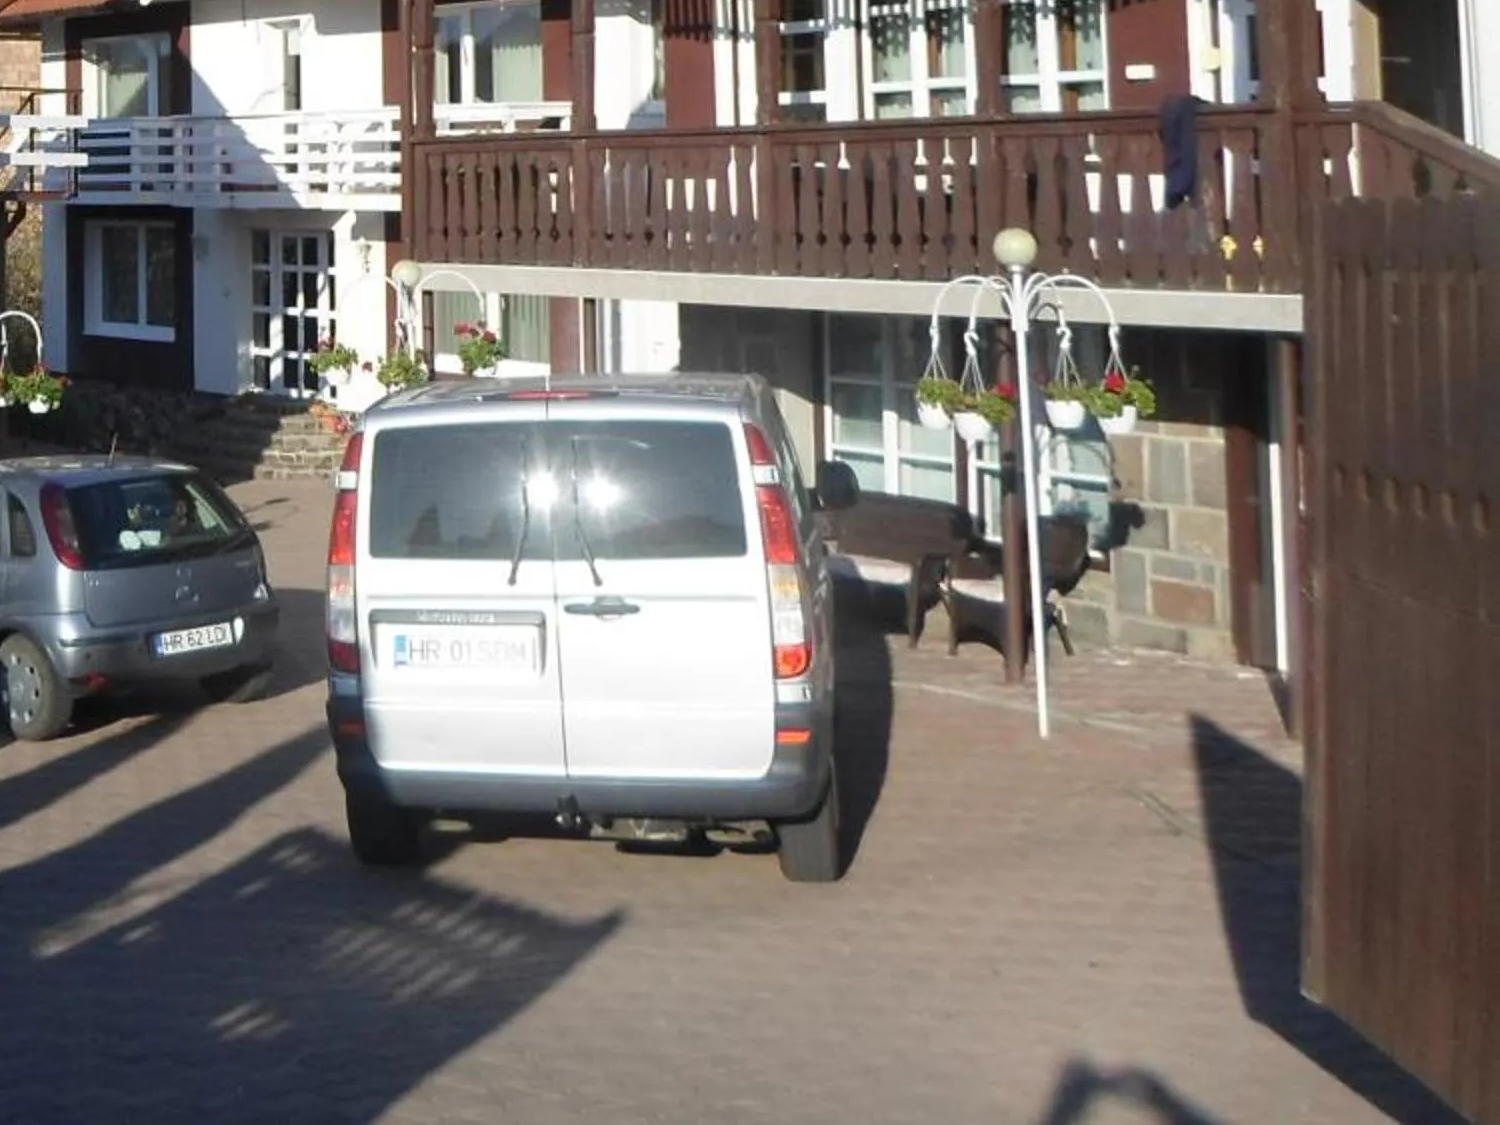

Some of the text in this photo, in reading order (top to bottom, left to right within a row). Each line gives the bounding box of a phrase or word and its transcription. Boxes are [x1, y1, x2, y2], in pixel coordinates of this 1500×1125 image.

[163, 634, 184, 652] HR
[187, 630, 203, 647] 62
[408, 638, 442, 663] HR
[449, 639, 472, 662] 01
